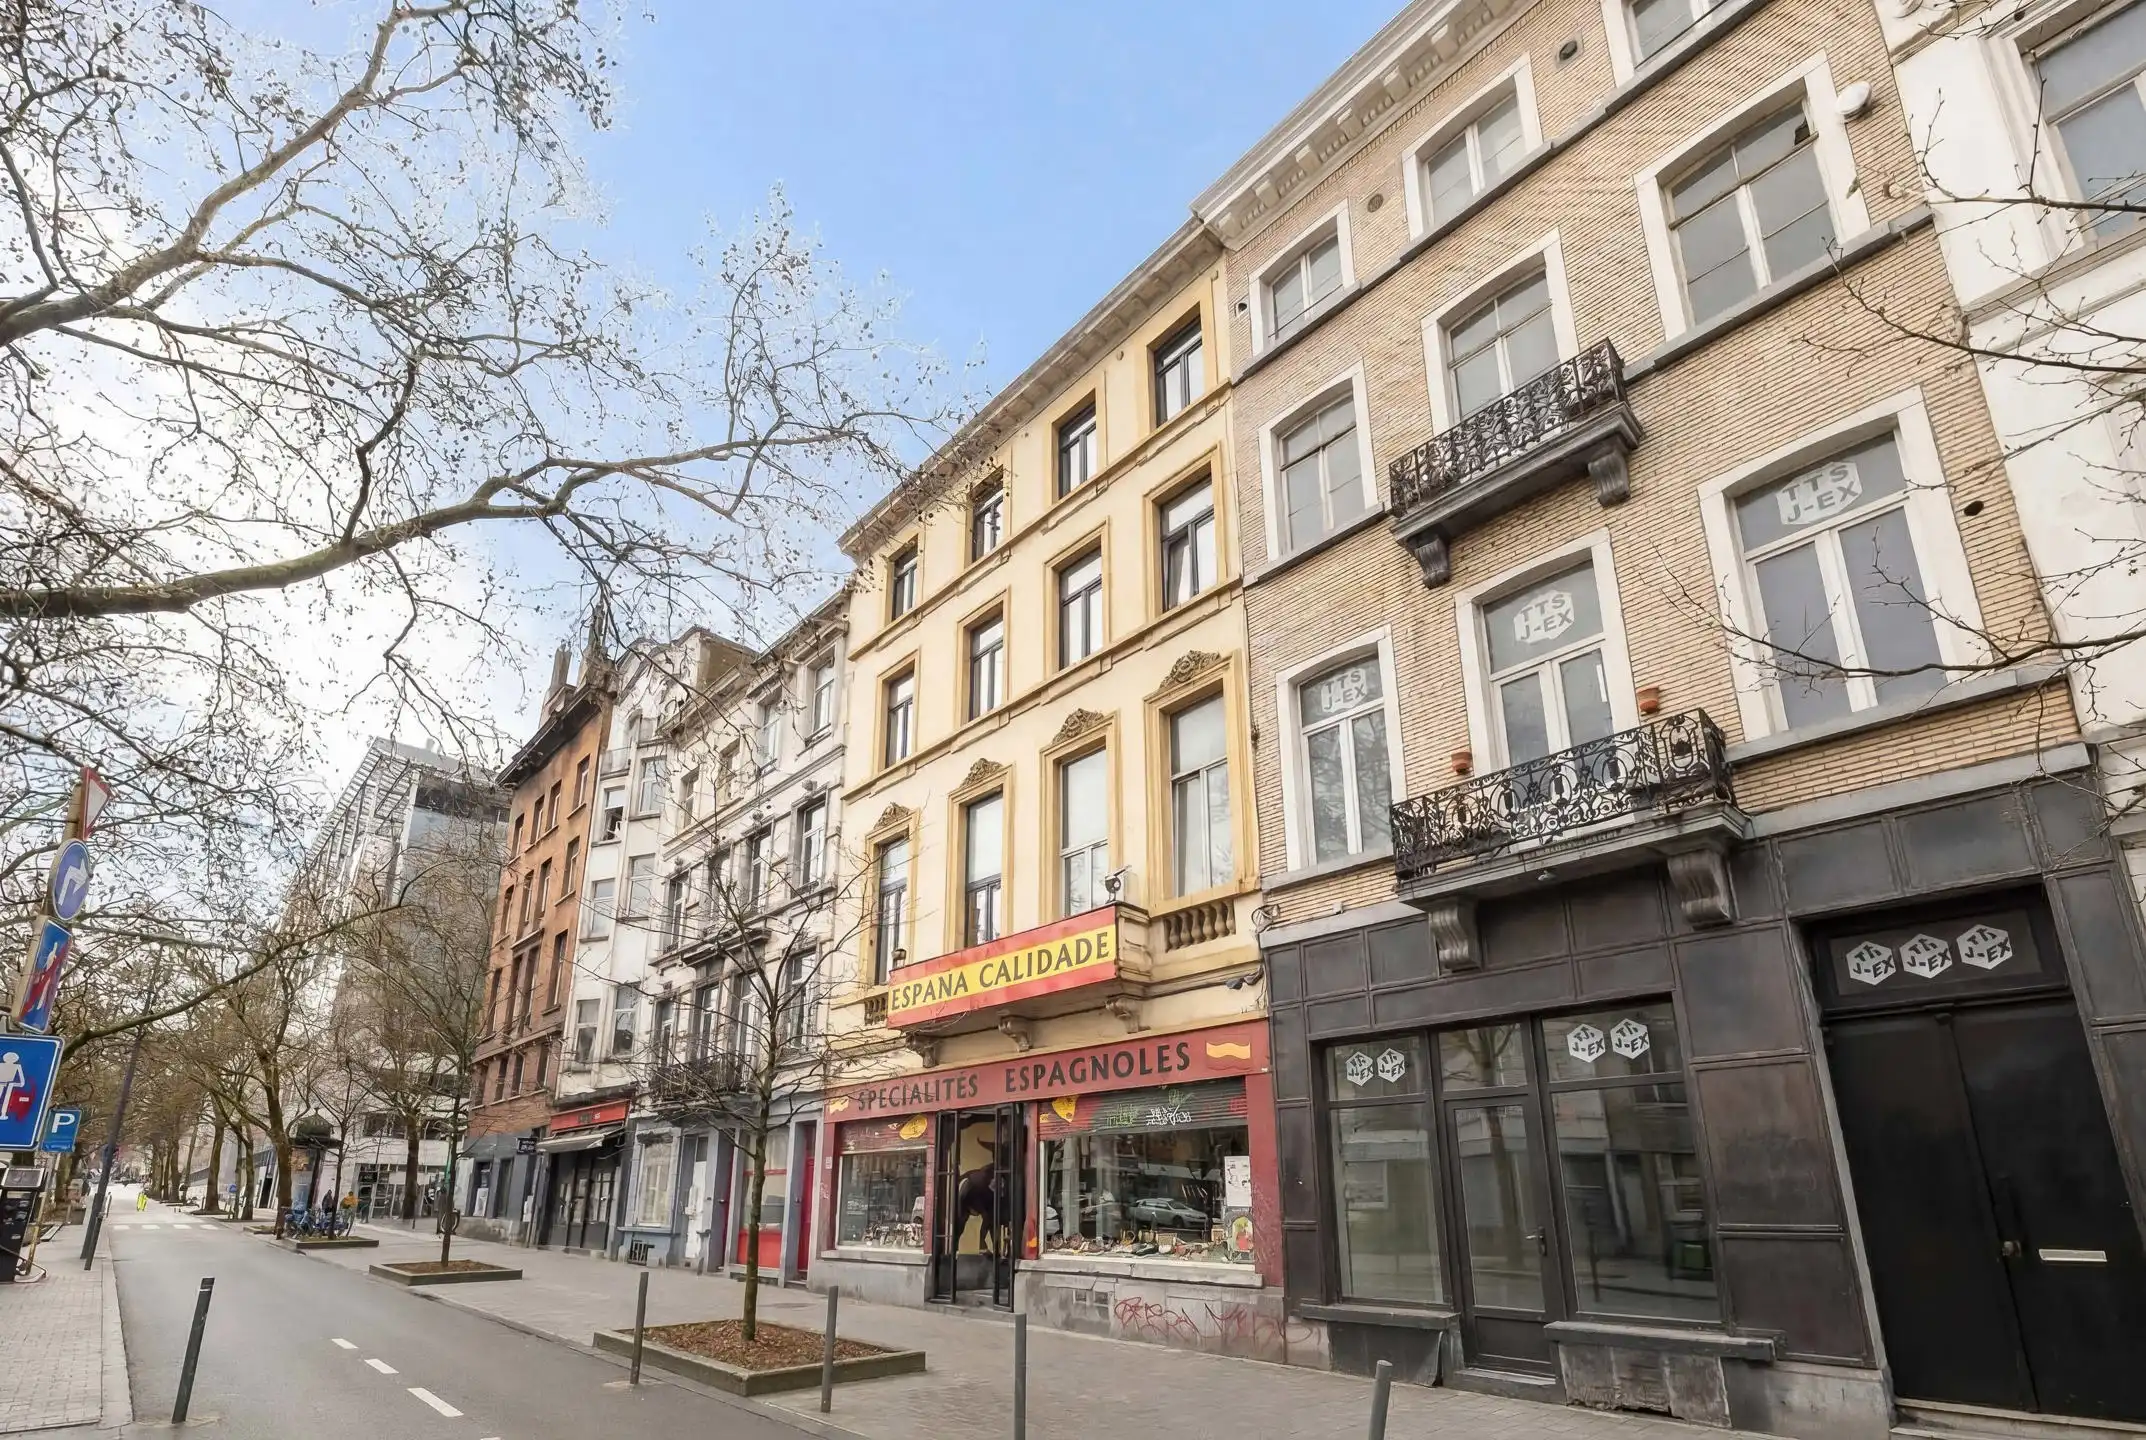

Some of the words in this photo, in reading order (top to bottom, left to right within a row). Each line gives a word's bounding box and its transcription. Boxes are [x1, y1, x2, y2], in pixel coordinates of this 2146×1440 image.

[1782, 465, 1849, 502] TTS
[1787, 481, 1859, 523] J-EX
[1520, 593, 1566, 623] TTS
[1520, 608, 1573, 640] J-EX
[1325, 670, 1362, 694] TTS
[1324, 683, 1366, 710] J-EX
[979, 931, 1110, 988] CALIDADE
[1906, 947, 1952, 972] J-EX
[1964, 937, 2011, 963] J-EX
[1852, 955, 1895, 978] J-EX
[1005, 1042, 1191, 1093] ESPAGNOLES
[51, 1113, 76, 1134] P
